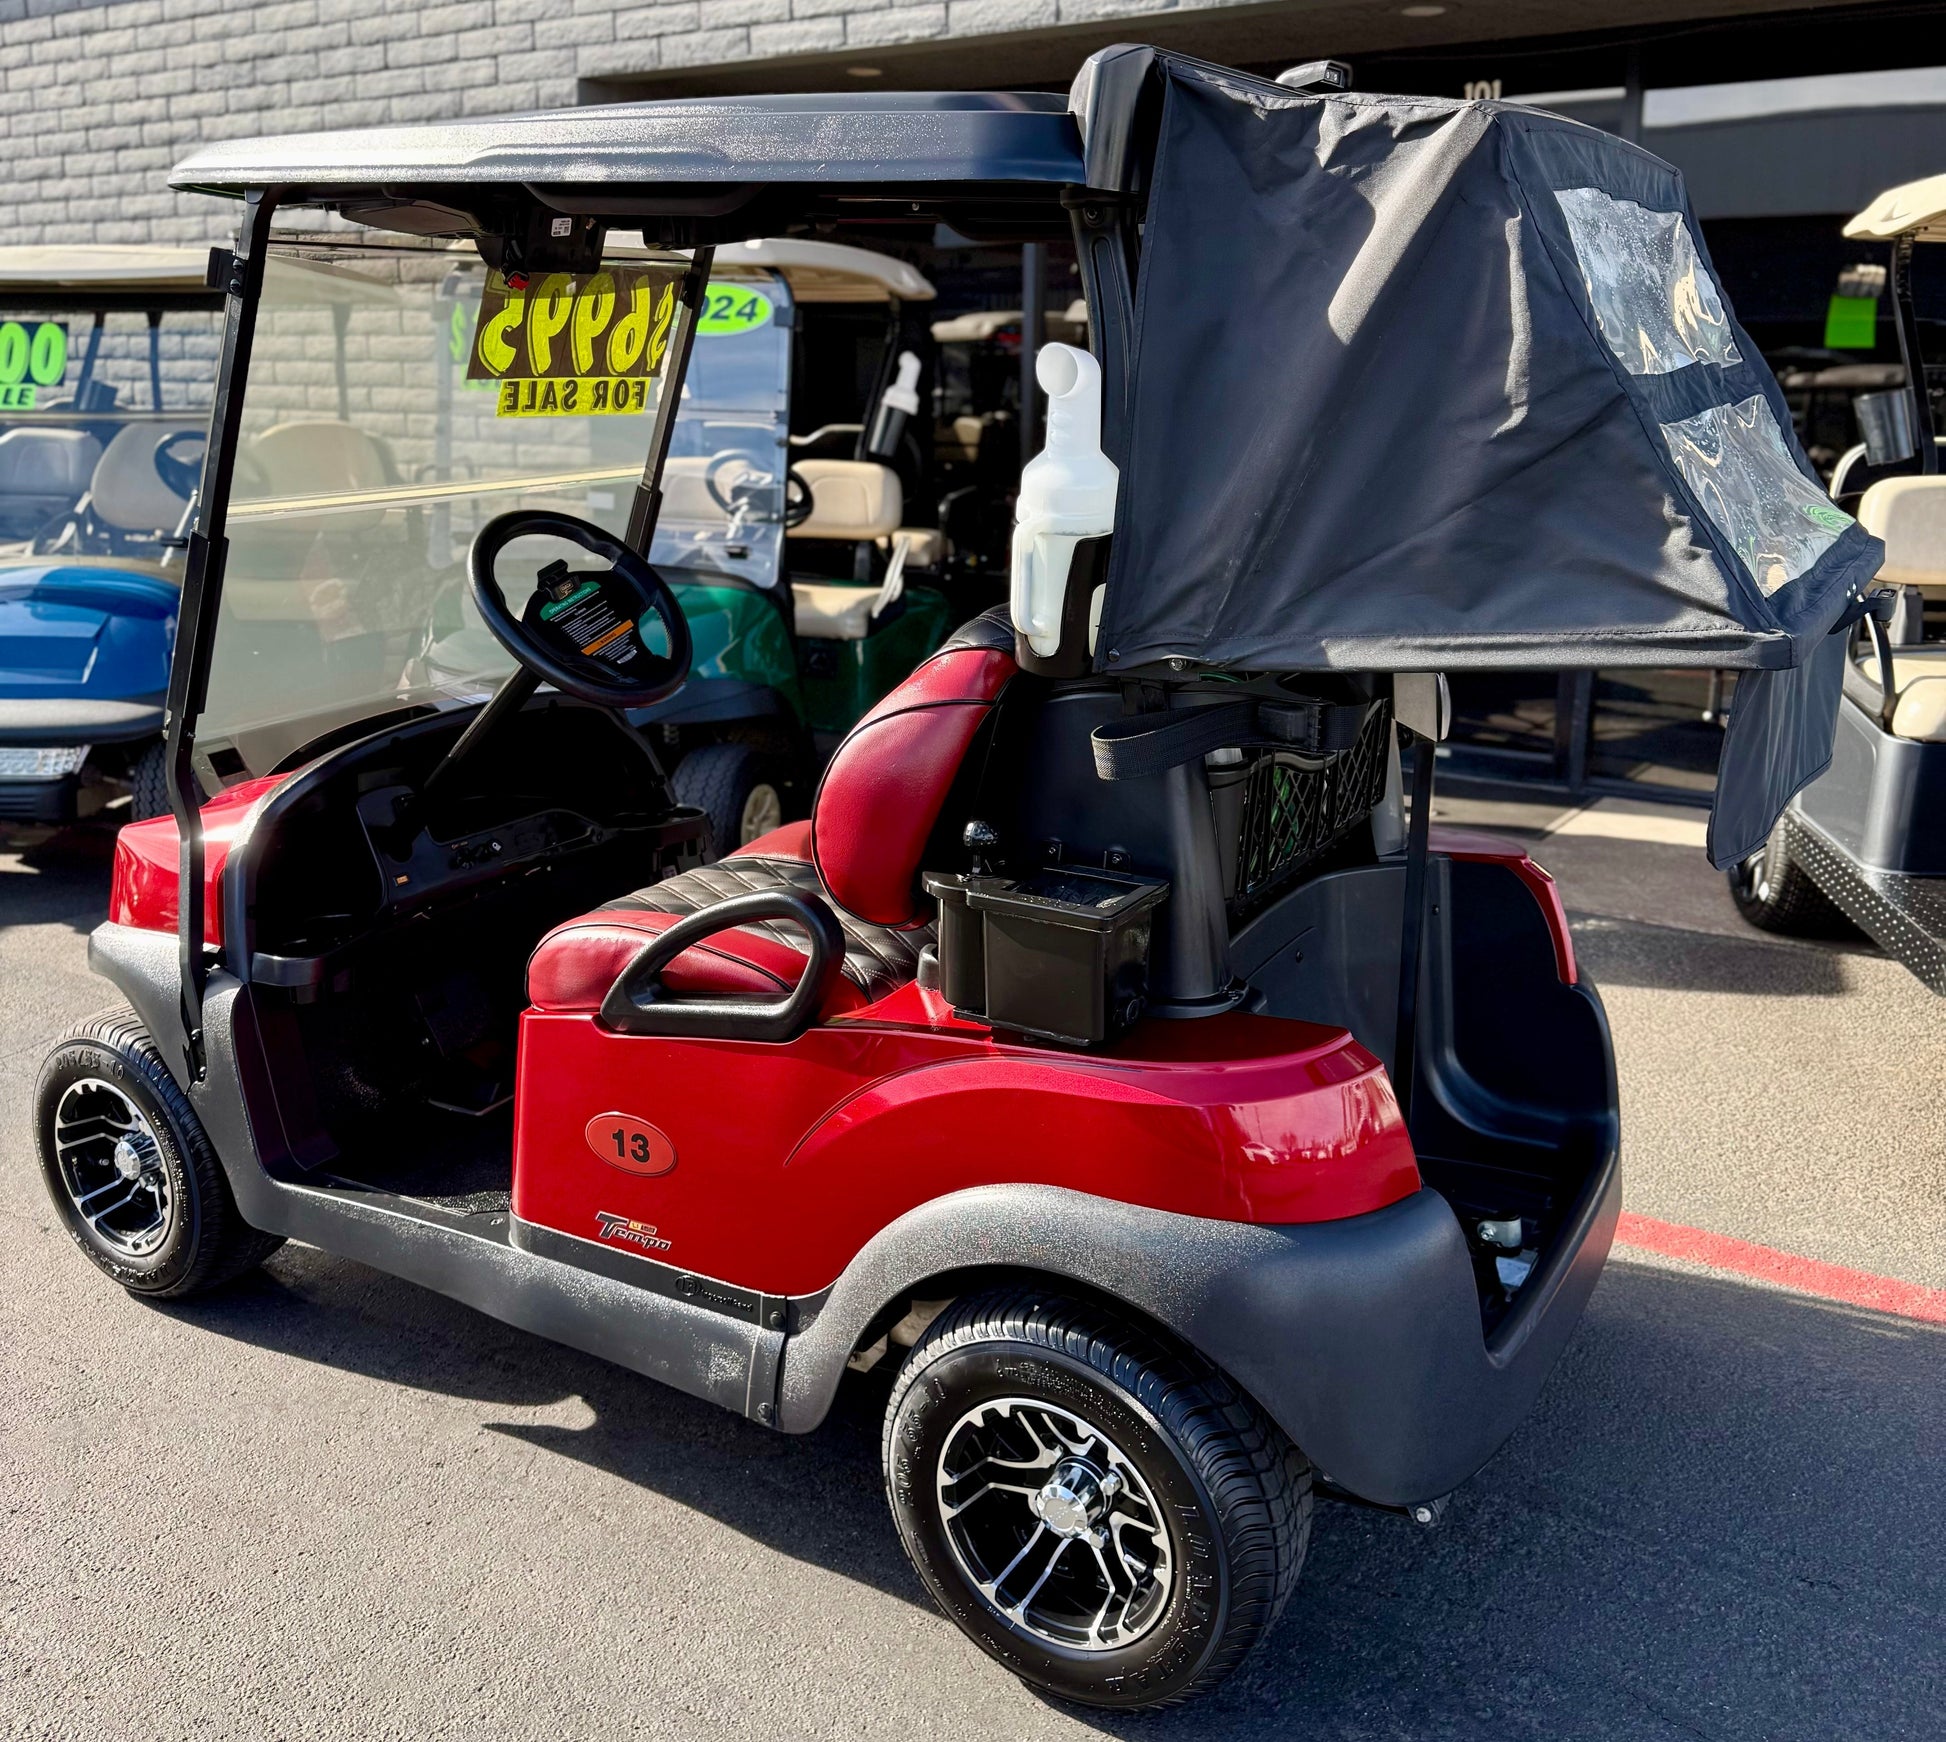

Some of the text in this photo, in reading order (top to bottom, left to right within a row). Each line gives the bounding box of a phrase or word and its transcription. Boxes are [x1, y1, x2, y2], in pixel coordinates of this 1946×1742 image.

[1464, 79, 1502, 100] 101
[612, 1128, 650, 1163] 13
[596, 1210, 672, 1251] Tempo
